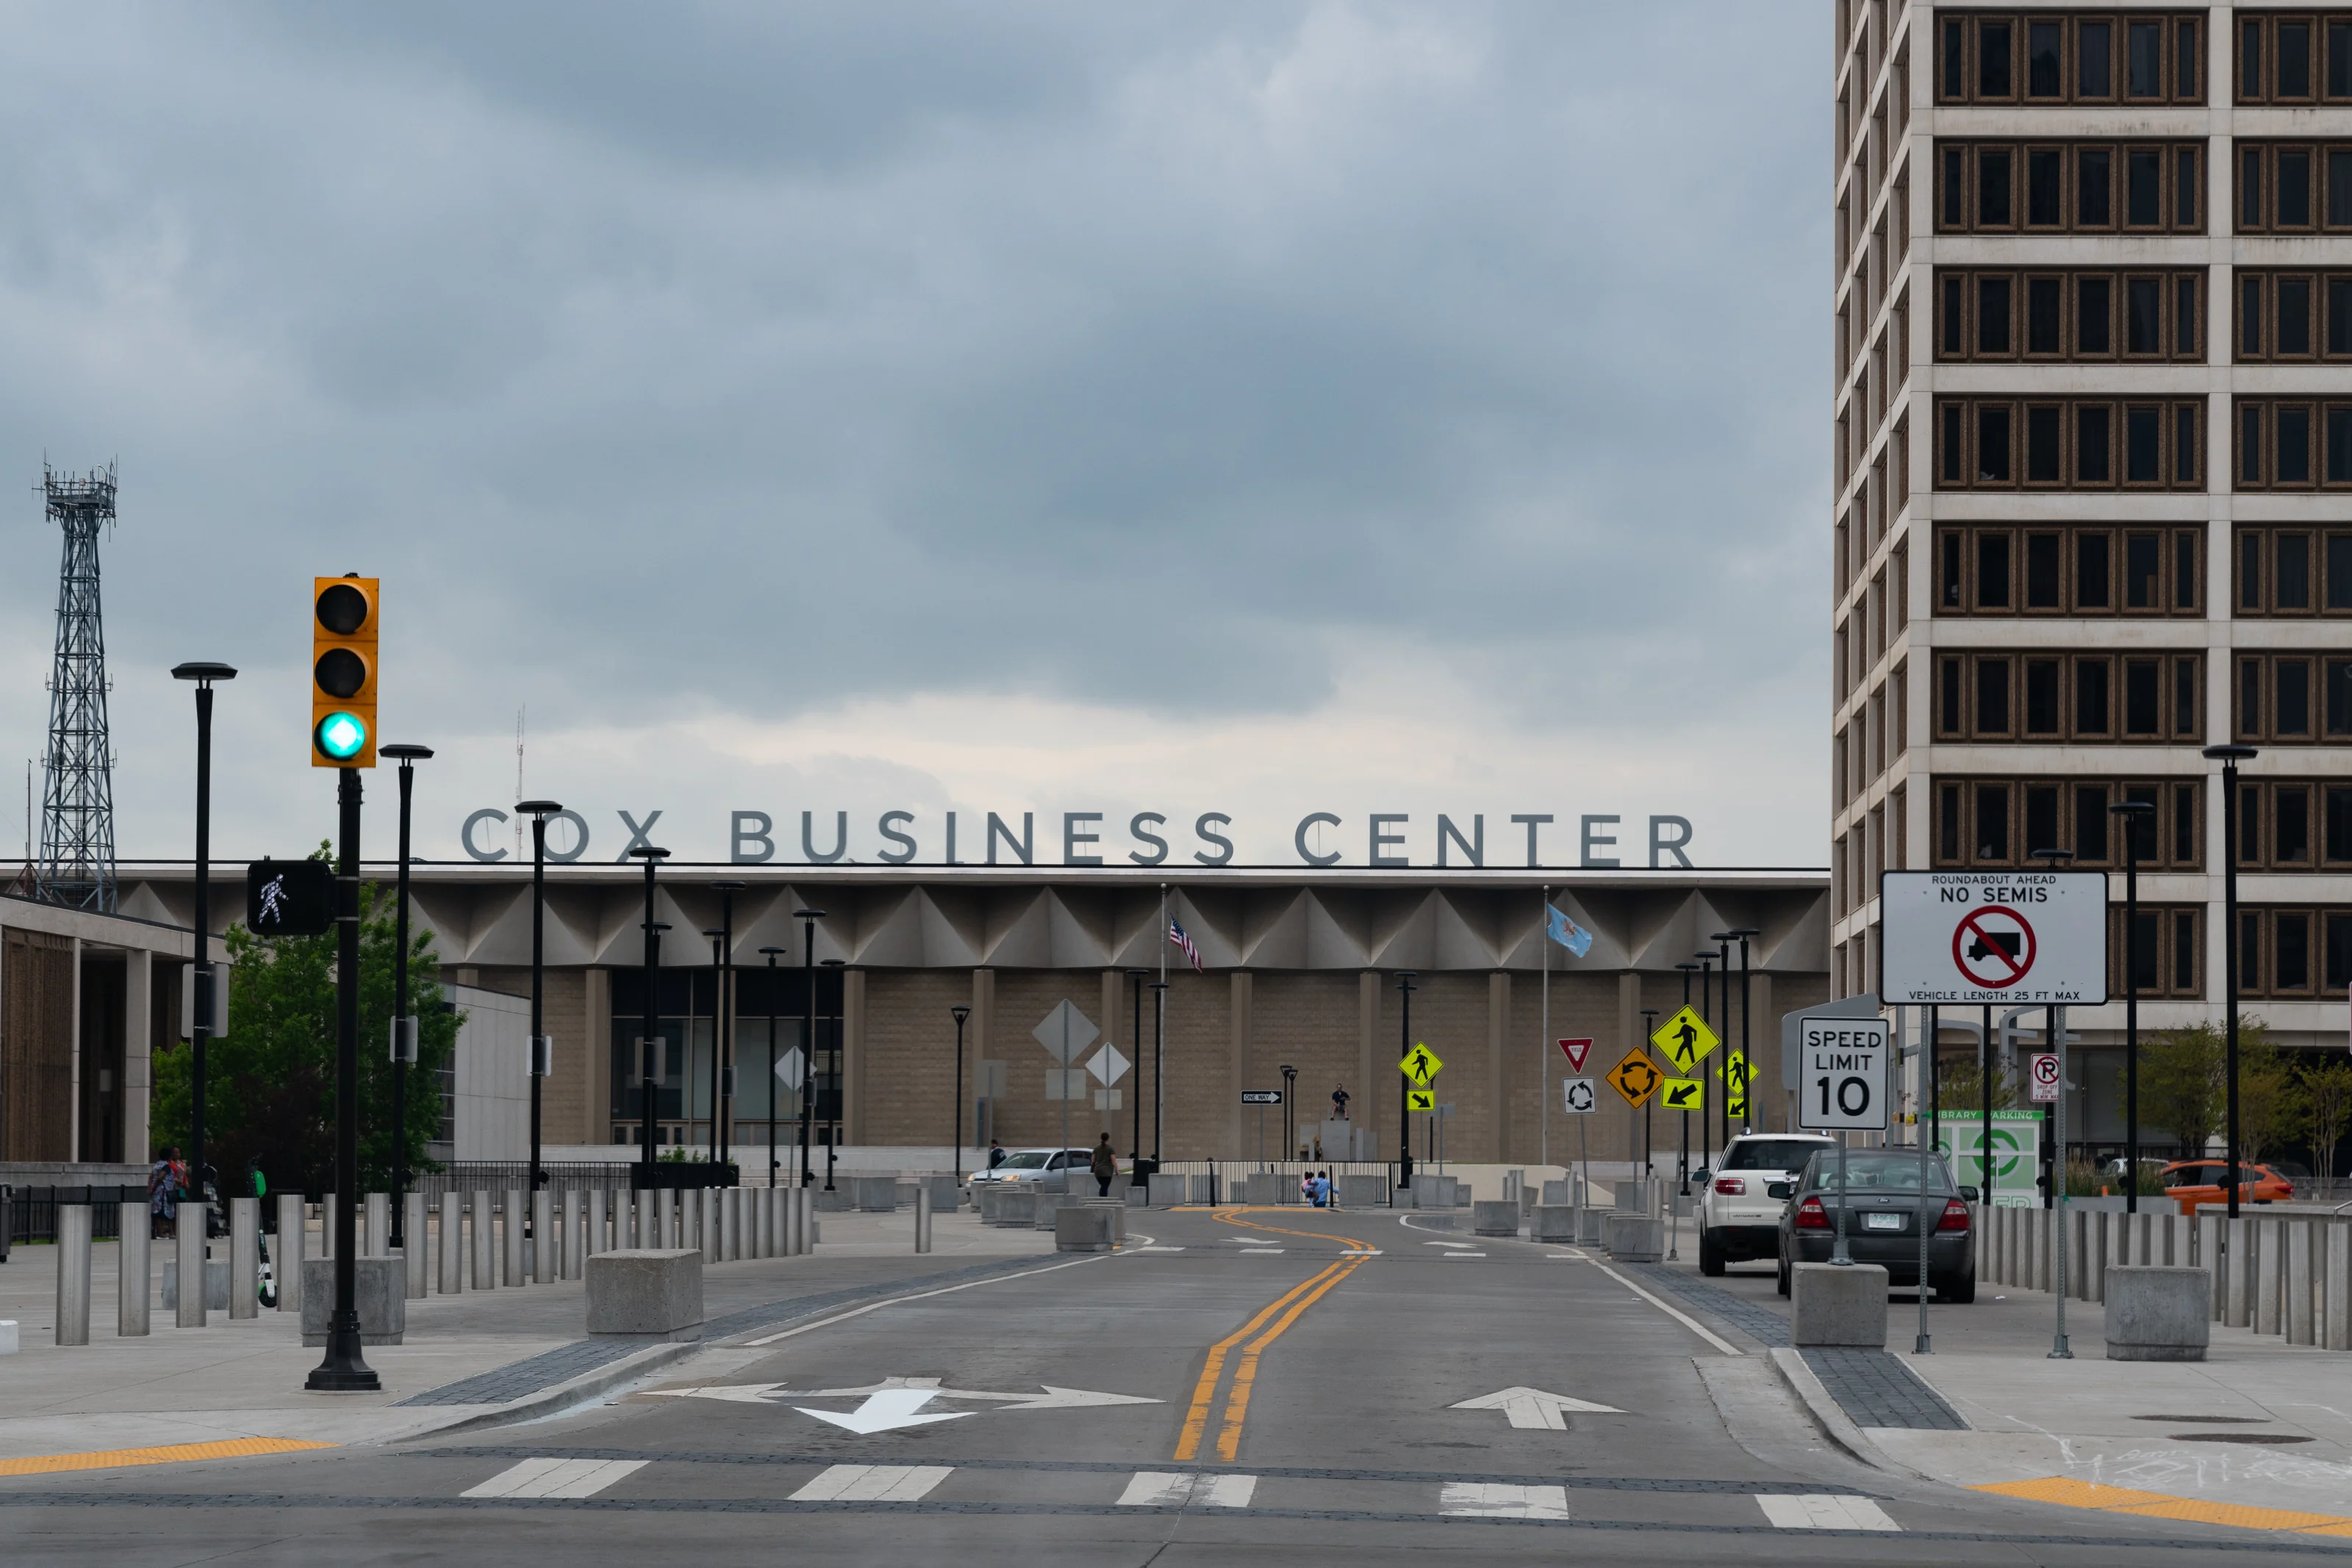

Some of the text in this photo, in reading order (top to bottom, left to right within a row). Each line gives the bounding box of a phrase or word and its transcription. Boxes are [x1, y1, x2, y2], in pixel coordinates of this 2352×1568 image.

[462, 808, 1695, 868] COX BUSINESS CENTER
[1932, 875, 2057, 884] ROUNDABOUT AHEAD
[1940, 887, 2048, 903] NO SEMIS
[1909, 991, 2080, 1000] VEHICLE LENGTH 25 FT MAX
[1807, 1030, 1882, 1049] SPEED
[1815, 1054, 1873, 1071] LIMIT
[1817, 1076, 1870, 1117] 10
[1990, 1112, 2033, 1120] ARKING
